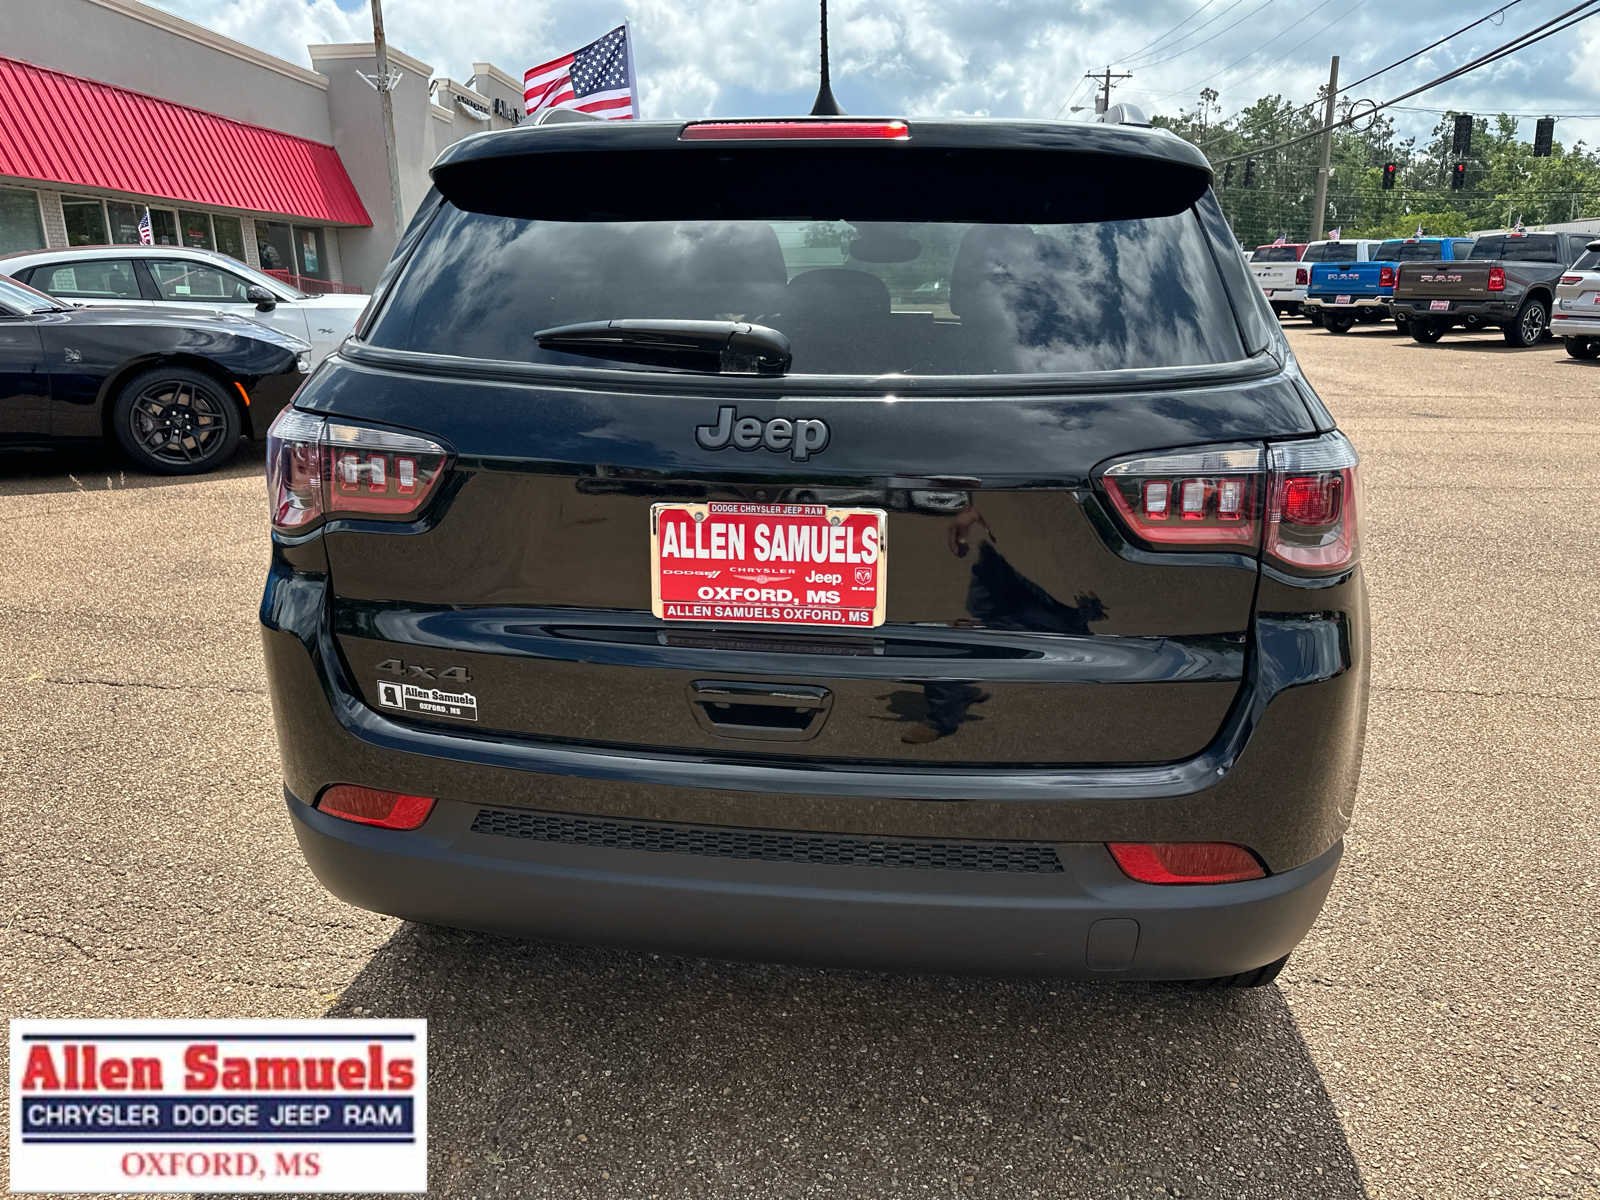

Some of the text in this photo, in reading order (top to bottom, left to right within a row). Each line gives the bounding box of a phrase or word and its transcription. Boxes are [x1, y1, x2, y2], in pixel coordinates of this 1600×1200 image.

[696, 405, 830, 461] Jeep
[711, 504, 823, 516] DODGE CHRYSLER JEEP RAM
[661, 521, 878, 565] ALLEN SAMUELS
[729, 566, 796, 575] CHRYSLER
[804, 570, 842, 586] Jeep
[697, 586, 841, 606] OXFORD, MS
[667, 605, 870, 623] ALLEN SAMUELS OXFORD, MS
[375, 658, 474, 684] 4x4
[404, 686, 475, 706] Allen Samuels
